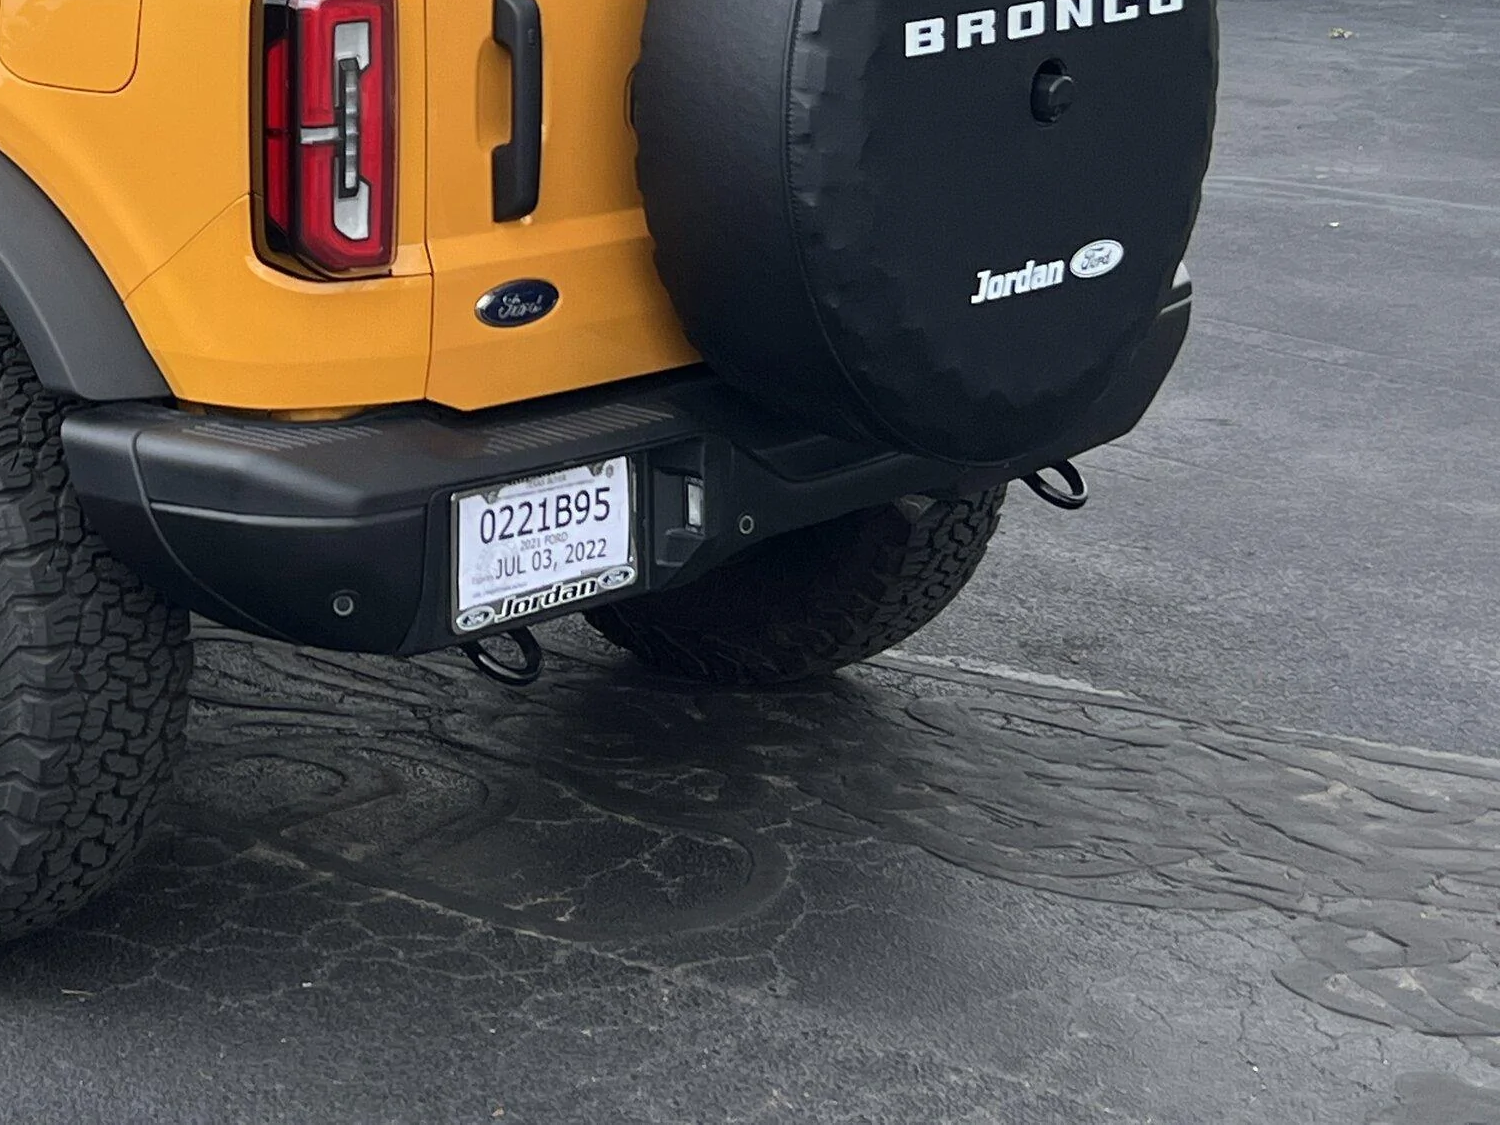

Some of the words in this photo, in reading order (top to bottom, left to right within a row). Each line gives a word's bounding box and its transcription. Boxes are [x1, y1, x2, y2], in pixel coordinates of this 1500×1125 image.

[970, 259, 1065, 304] Jordan
[480, 487, 610, 544] 0221B95
[496, 555, 526, 579] JUL
[531, 548, 557, 572] 03,
[565, 538, 607, 564] 2022
[520, 538, 542, 551] 2021
[544, 531, 569, 546] FORD
[495, 578, 598, 623] Jordan
